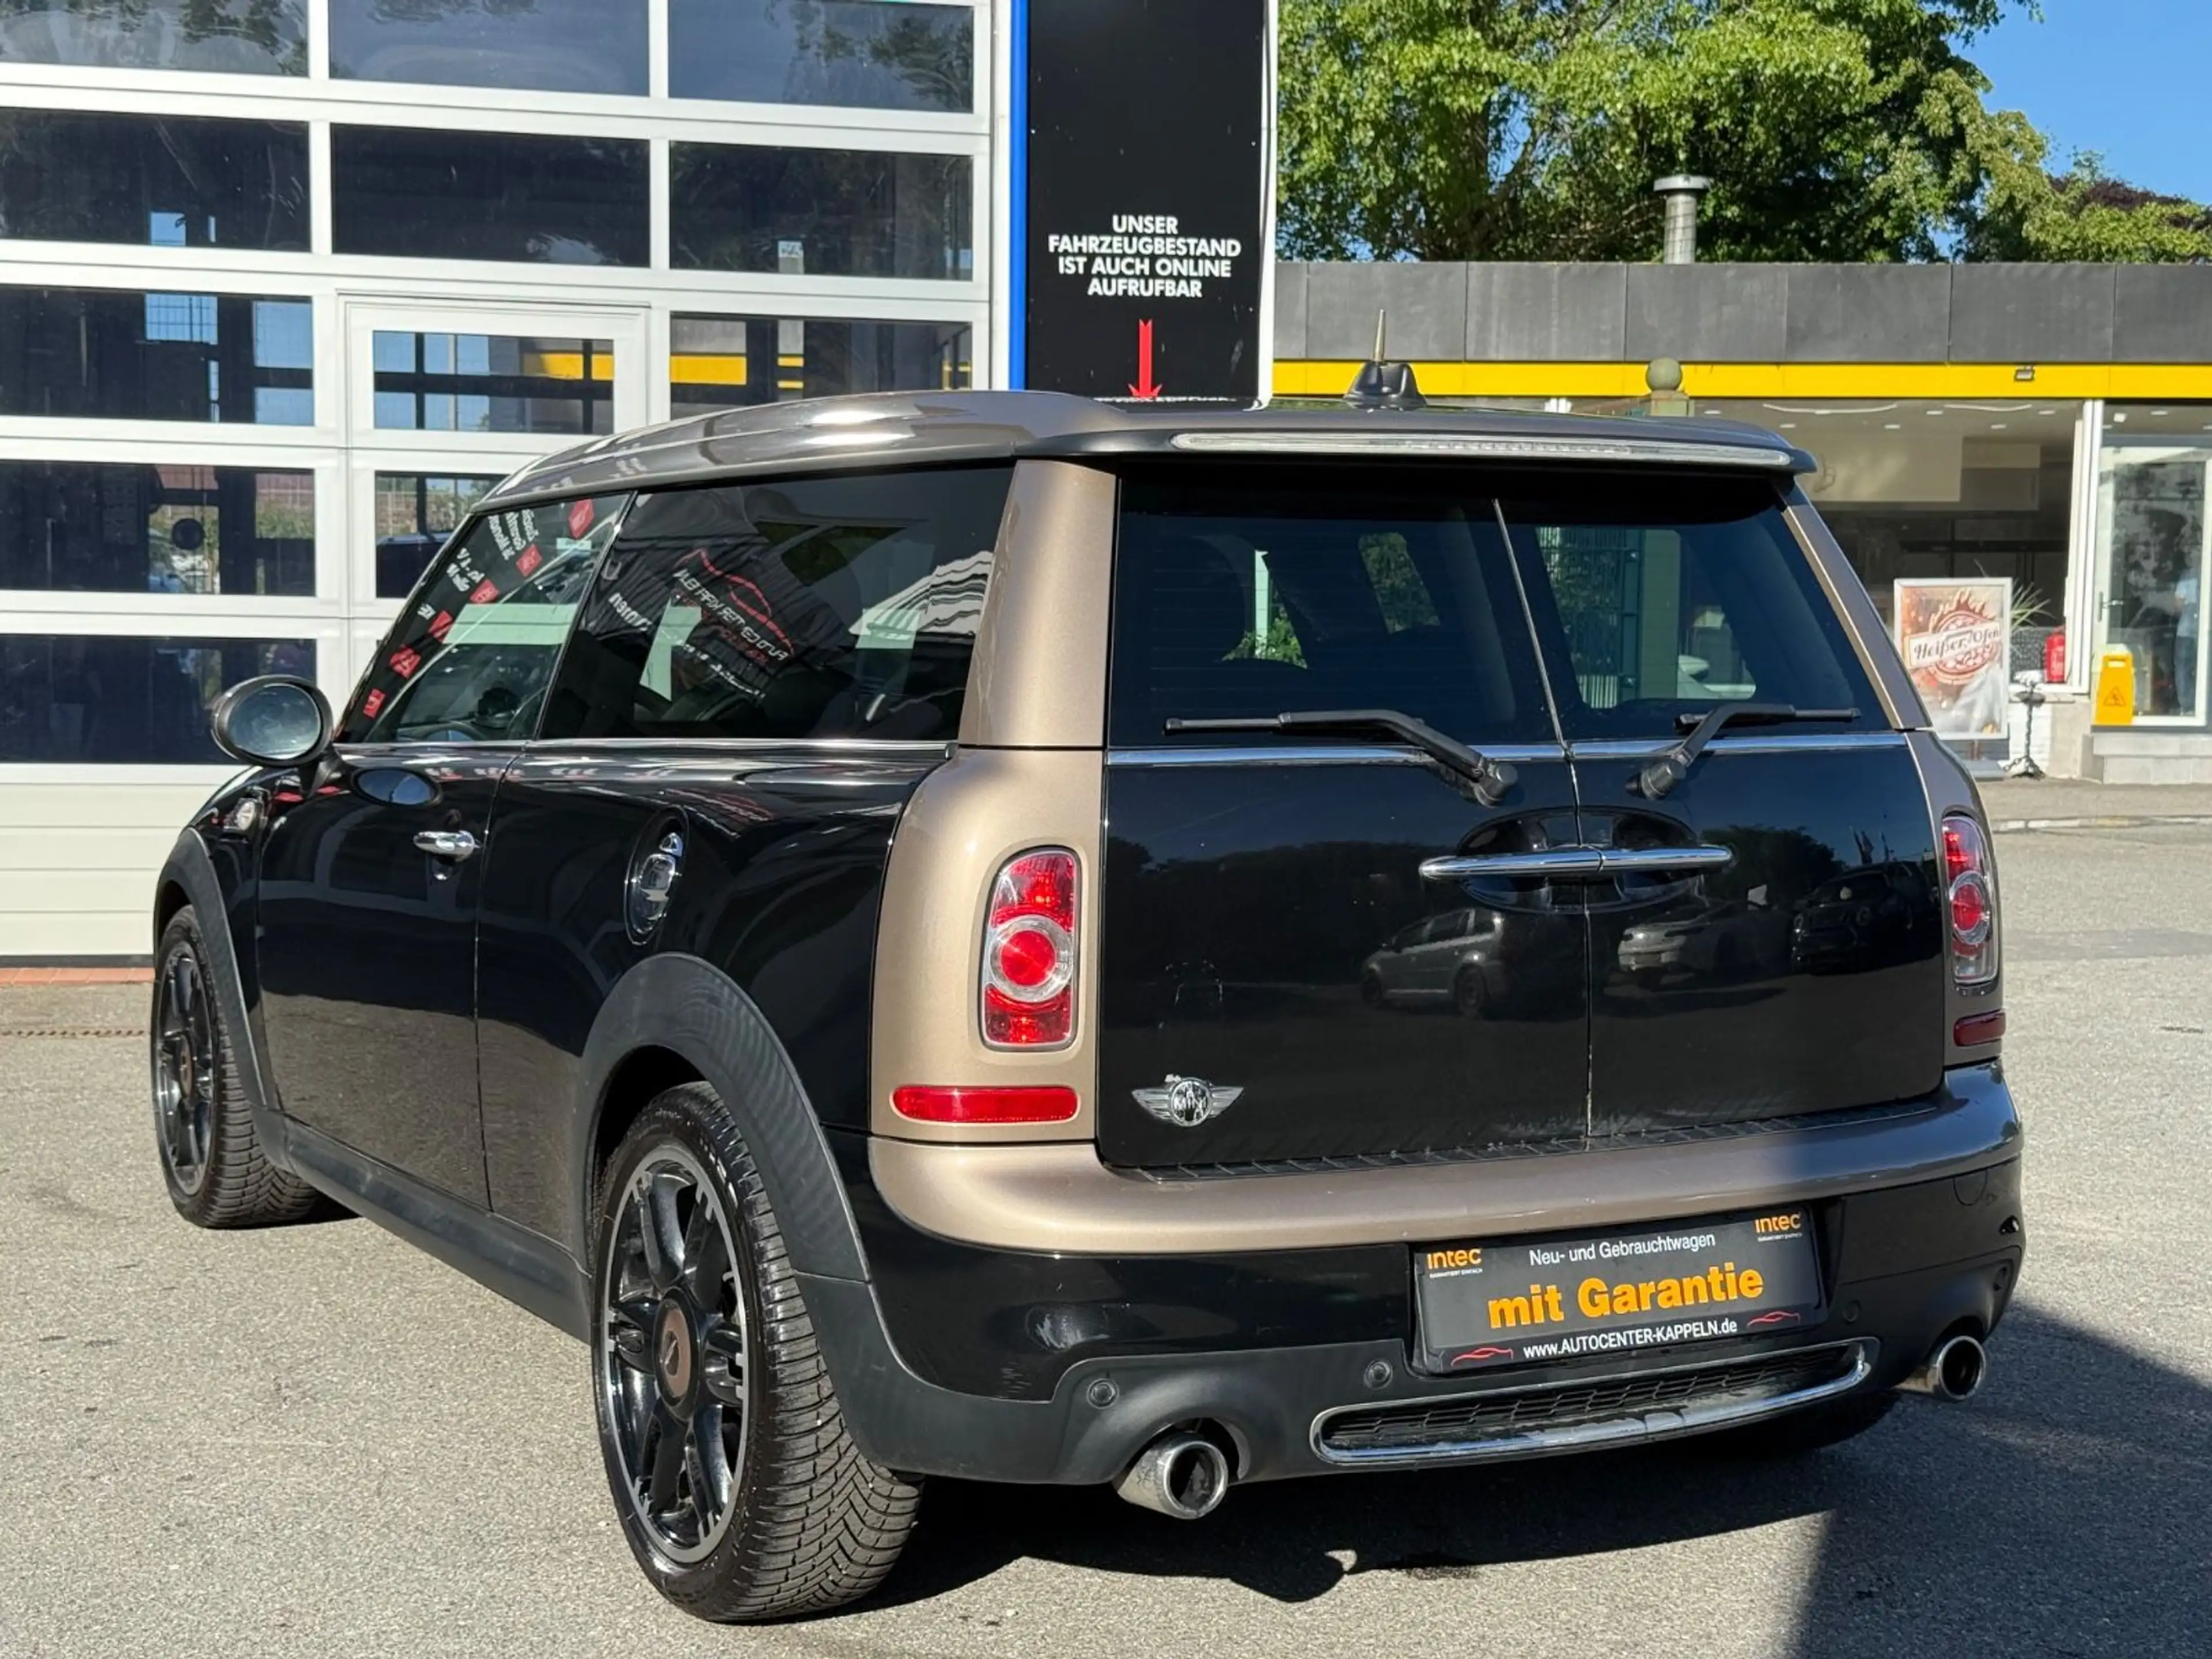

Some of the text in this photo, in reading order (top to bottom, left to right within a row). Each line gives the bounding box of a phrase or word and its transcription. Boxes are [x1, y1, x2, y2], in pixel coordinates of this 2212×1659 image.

[1112, 215, 1178, 234] UNSER
[1048, 234, 1241, 257] FAHRZEUGBESTAND
[1058, 256, 1232, 278] IST AUCH ONLINE
[1088, 278, 1202, 298] AUFRUFBAR
[1427, 1248, 1482, 1270] intec
[1529, 1234, 1715, 1266] Neu- und Gebrauchtwagen
[1488, 1262, 1764, 1329] mit Garantie
[1523, 1317, 1738, 1358] www.AUTOCENTER-KAPPELN.de
